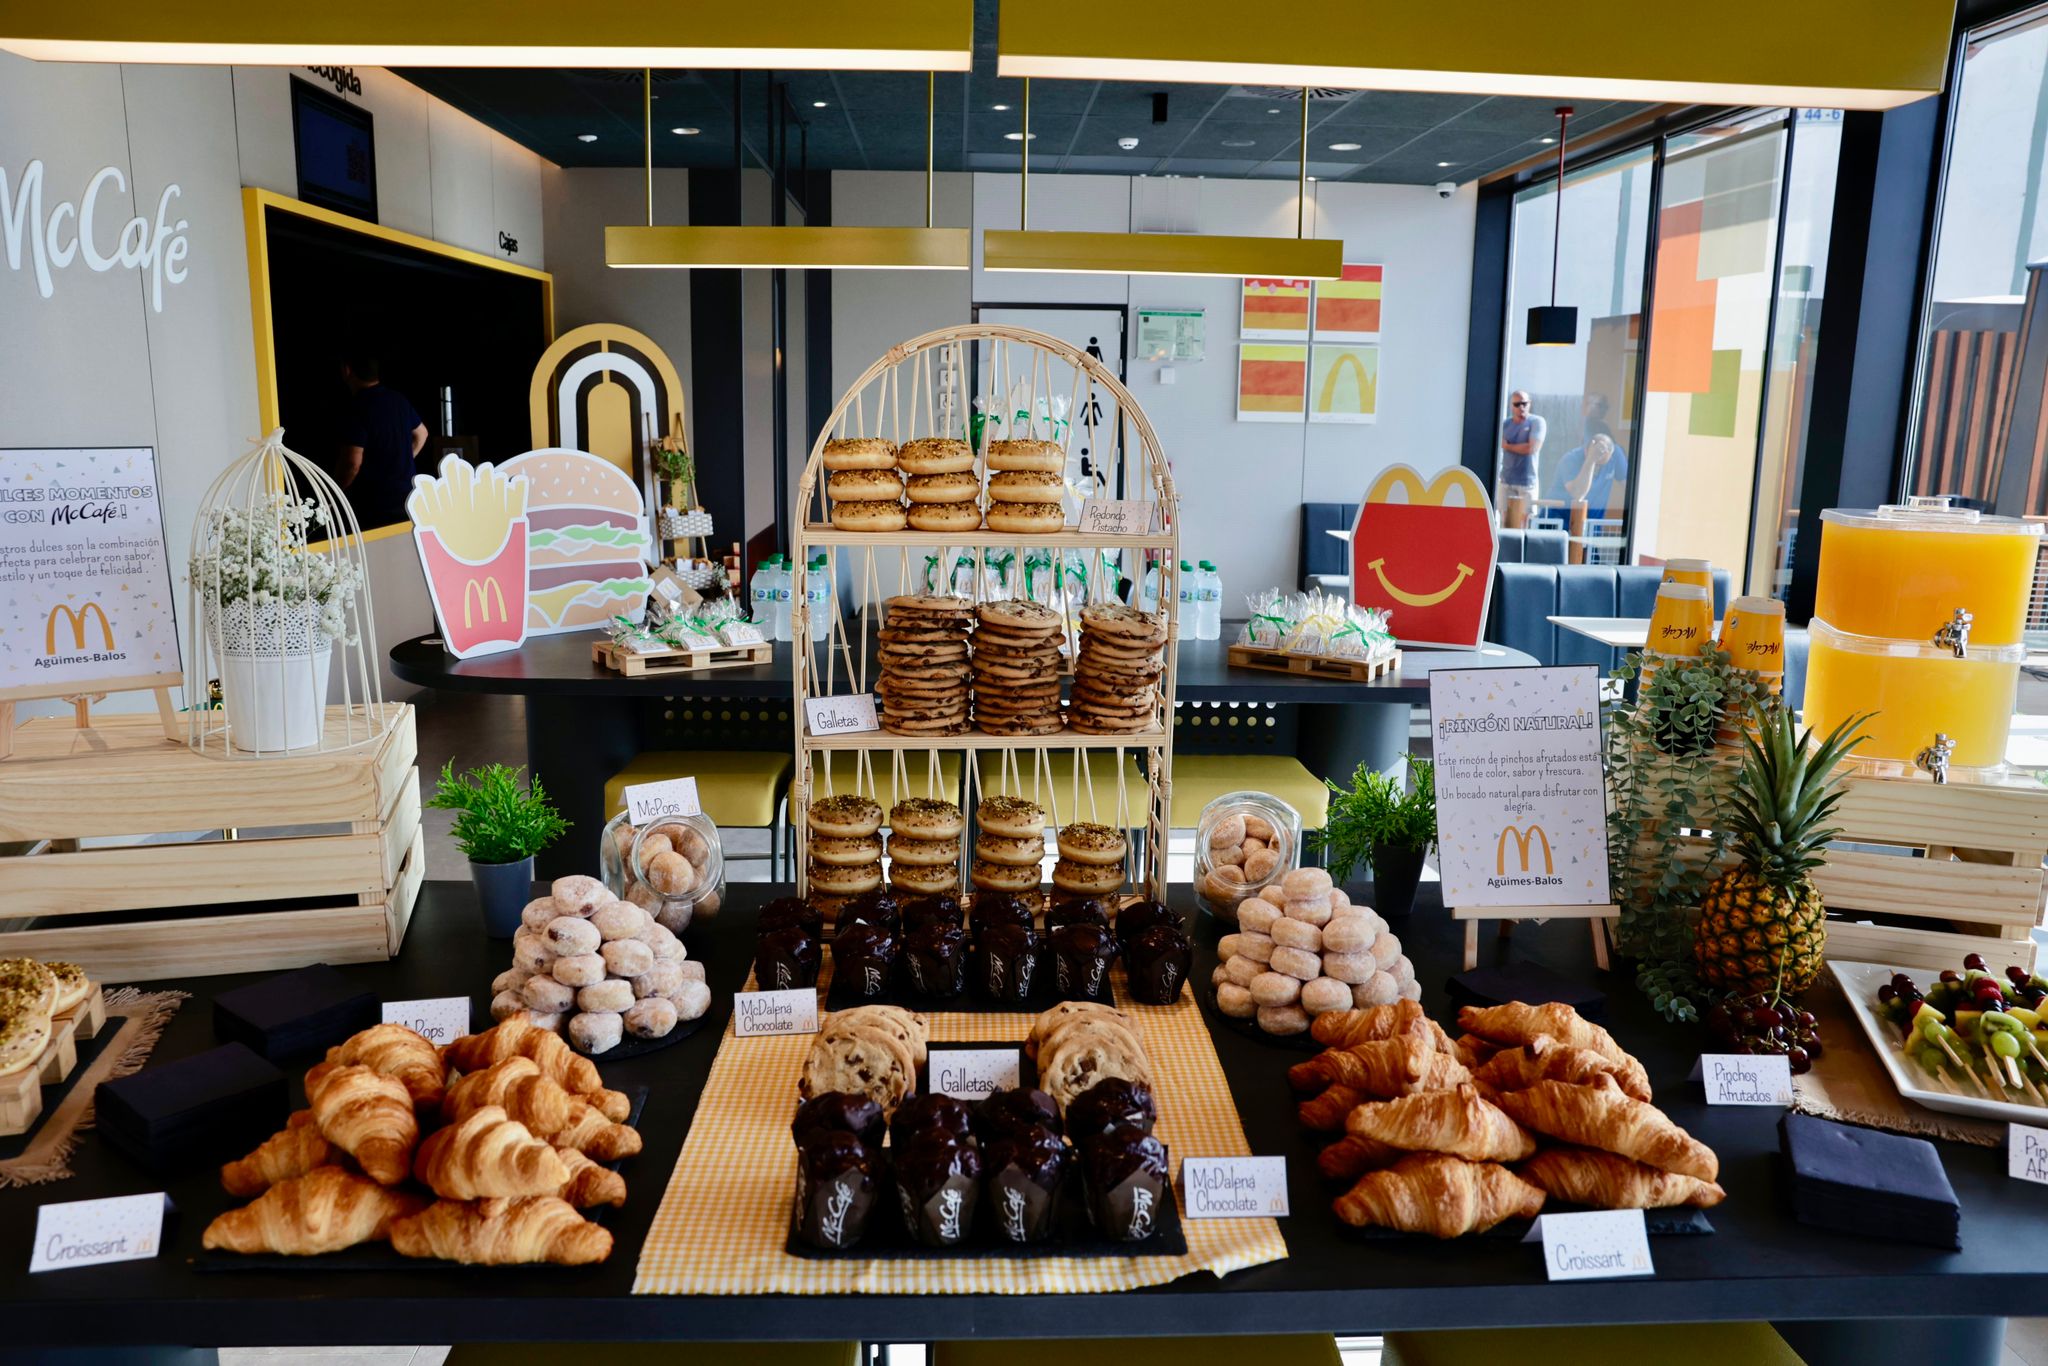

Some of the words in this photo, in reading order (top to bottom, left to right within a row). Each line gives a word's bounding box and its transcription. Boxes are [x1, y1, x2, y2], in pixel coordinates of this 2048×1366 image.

[0, 159, 189, 313] McCafé
[499, 231, 518, 256] Cajas
[49, 486, 153, 501] MOMENTOS
[4, 509, 45, 524] CON
[1090, 505, 1127, 521] Redondo
[1091, 519, 1128, 533] Pistacho
[29, 539, 63, 553] dulces
[66, 543, 83, 551] son
[86, 537, 96, 550] la
[99, 536, 159, 549] combinación
[34, 558, 57, 569] para
[60, 550, 101, 565] celebrar
[0, 567, 26, 582] stilo
[29, 573, 35, 583] y
[38, 571, 50, 580] un
[54, 569, 83, 581] toque
[86, 564, 98, 577] de
[34, 652, 127, 669] Agüimes-Balos
[816, 709, 859, 730] Galletas
[1514, 712, 1593, 732] NATURAL!
[1438, 752, 1457, 766] Este
[1459, 753, 1486, 765] rincón
[1488, 751, 1498, 764] de
[1501, 750, 1534, 766] pinchos
[1536, 749, 1577, 763] afrutados
[1579, 751, 1598, 762] está
[1450, 769, 1471, 779] lleno
[1473, 765, 1483, 778] de
[1485, 766, 1510, 779] color,
[1512, 765, 1536, 777] sabor
[1538, 769, 1544, 780] y
[1546, 764, 1584, 776] frescura.
[1441, 787, 1454, 799] Un
[1456, 786, 1487, 799] bocado
[1488, 784, 1519, 798] natural
[1521, 788, 1541, 800] para
[1543, 782, 1580, 797] disfrutar
[1583, 787, 1599, 796] con
[637, 798, 681, 818] McPops
[1504, 799, 1536, 814] alegría.
[1487, 876, 1563, 889] Agüimes-Balos
[741, 996, 792, 1017] McDalena
[743, 1013, 793, 1032] Chocolate
[941, 1067, 994, 1093] Galletas
[1714, 1061, 1758, 1083] Pinchos
[1719, 1081, 1772, 1102] Afrutados
[1192, 1165, 1256, 1190] McDalena
[1196, 1189, 1258, 1212] Chocolate
[46, 1233, 128, 1262] Croissant
[1556, 1243, 1625, 1272] Croissant
